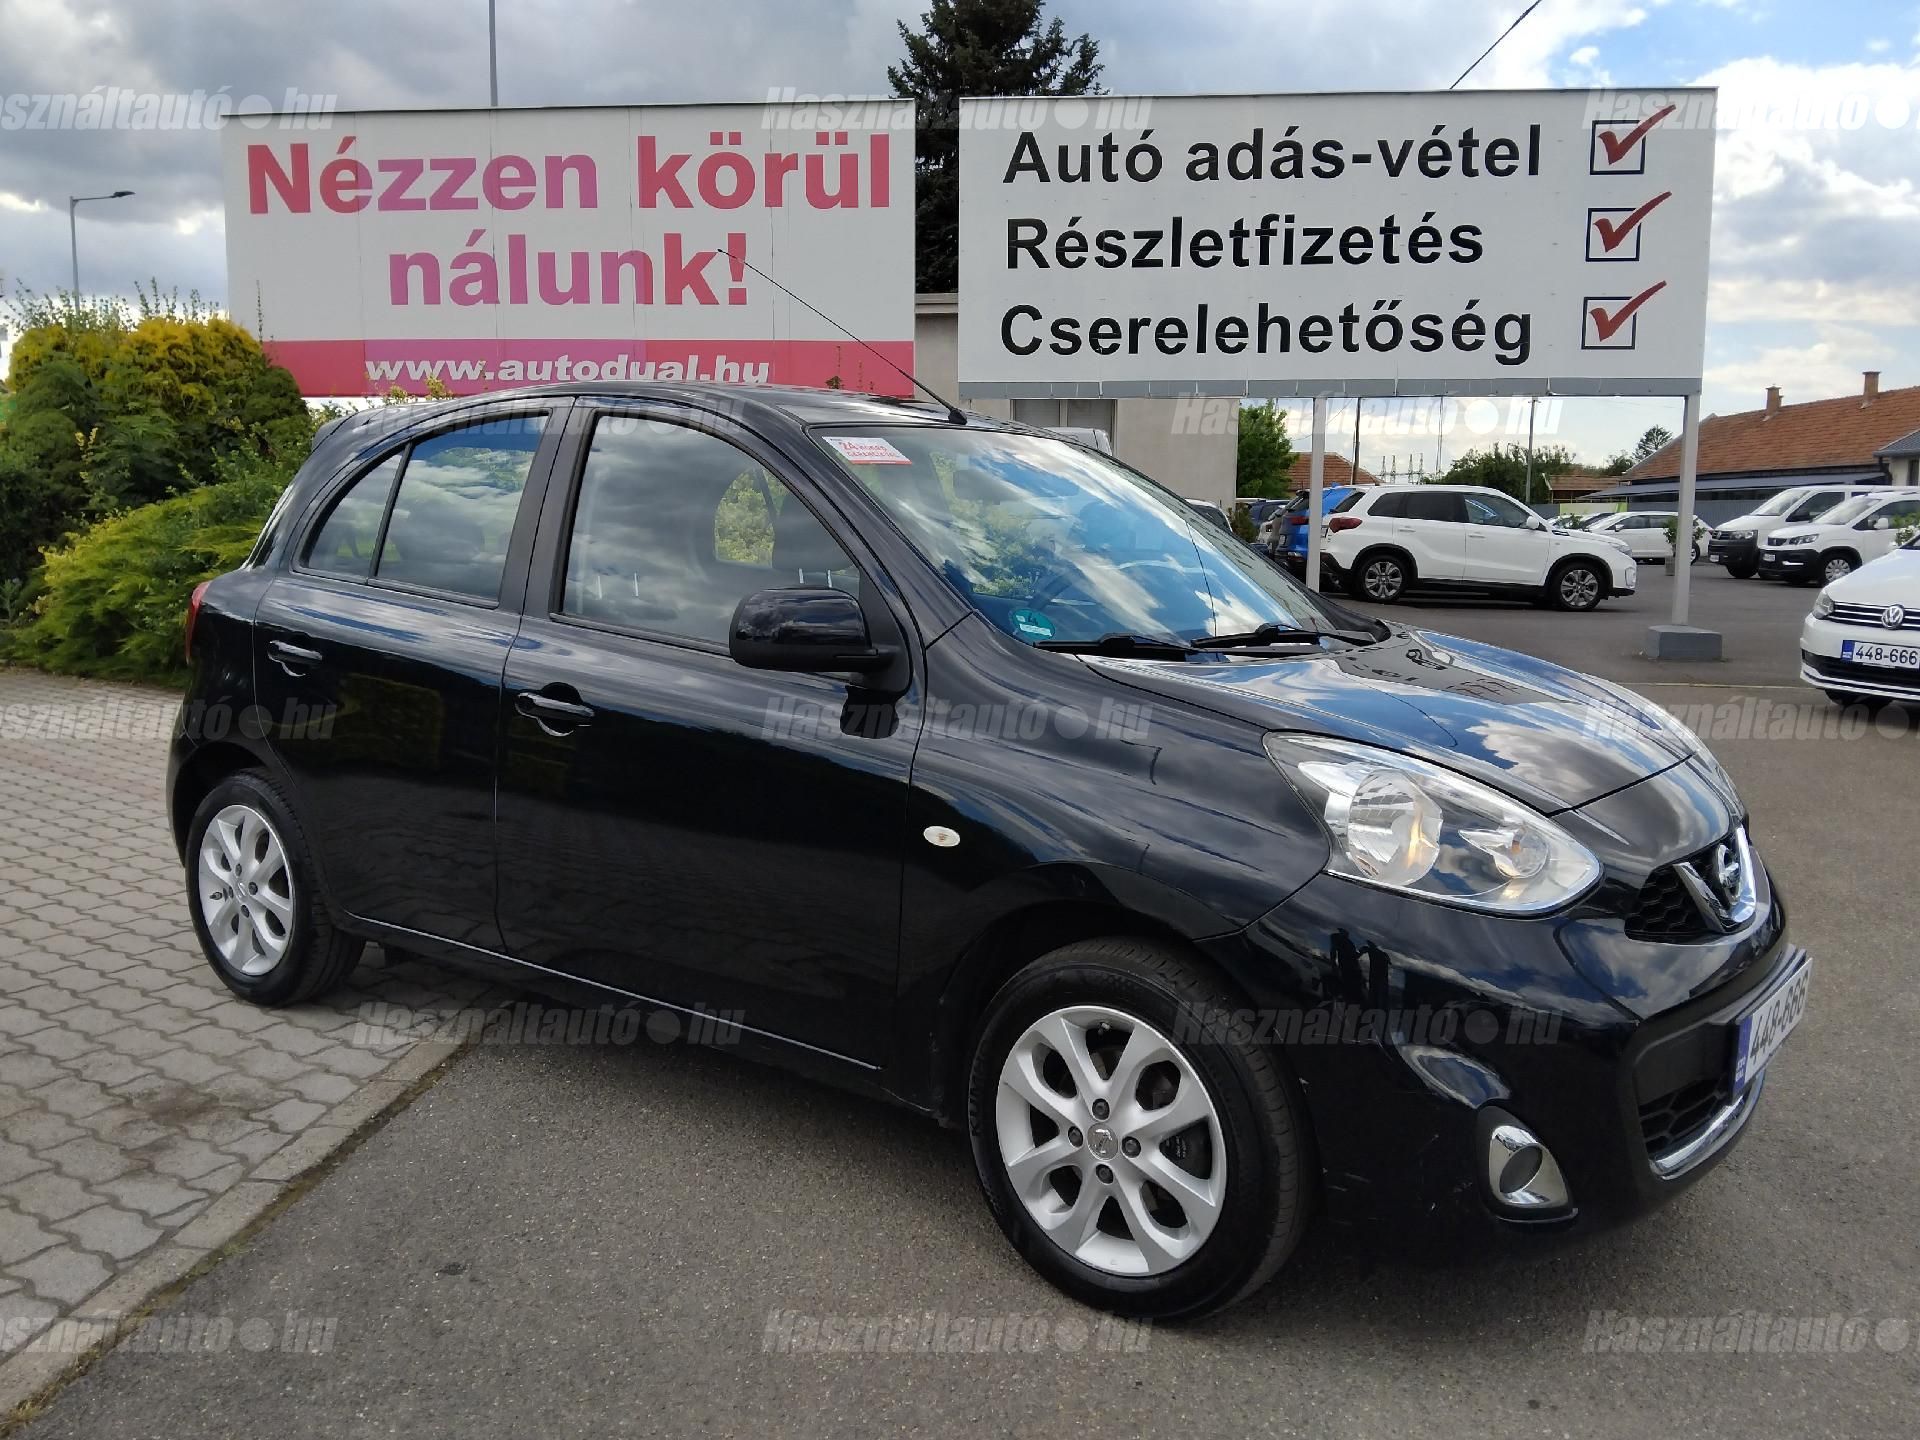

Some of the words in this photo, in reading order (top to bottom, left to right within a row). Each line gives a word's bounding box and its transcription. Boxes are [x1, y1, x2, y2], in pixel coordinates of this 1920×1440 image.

[247, 136, 598, 214] Nézzen
[637, 131, 890, 209] körül
[1002, 129, 1163, 183] Autó
[1185, 124, 1540, 182] adás-vétel
[390, 229, 748, 306] nálunk!
[1007, 211, 1483, 269] Részletfizetés
[1000, 298, 1531, 366] Cserelehetőség
[365, 354, 770, 384] www.autodual.hu
[1855, 645, 1919, 665] 448-666
